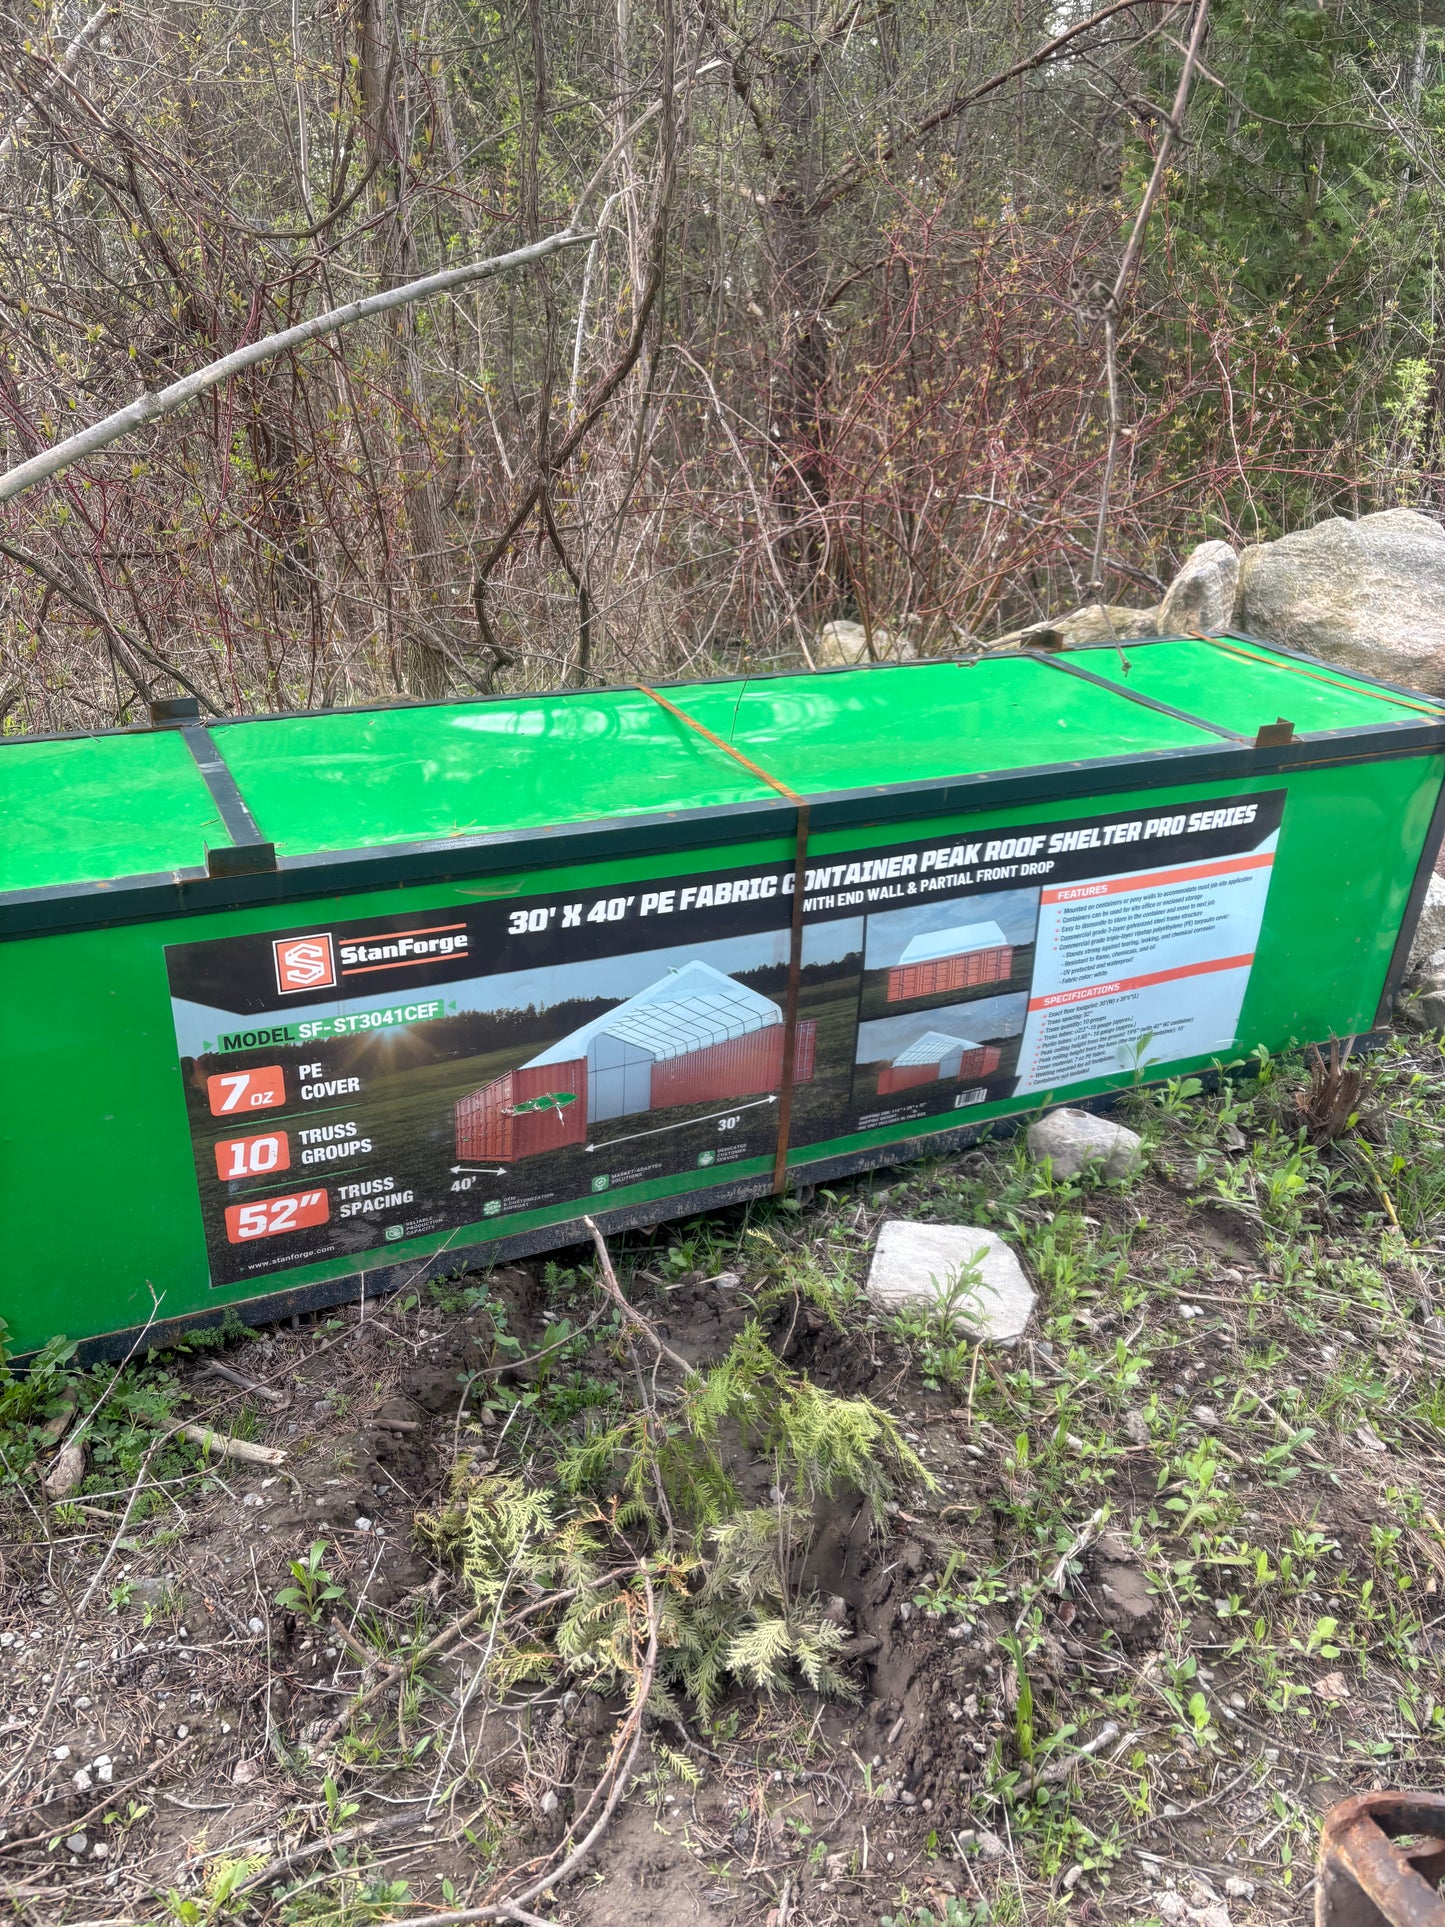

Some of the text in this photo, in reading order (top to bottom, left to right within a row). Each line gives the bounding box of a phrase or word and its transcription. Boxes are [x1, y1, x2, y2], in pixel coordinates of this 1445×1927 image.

[508, 907, 556, 934] 30'
[562, 904, 582, 928] X
[640, 890, 676, 916] PE
[680, 876, 777, 910] FABRIC
[782, 854, 918, 894] CONTAINER
[920, 843, 981, 872] PEAK
[984, 835, 1046, 862] ROOF
[1048, 822, 1142, 853] SHELTER
[1143, 815, 1186, 840] PRO
[1187, 804, 1258, 833] SERIES
[803, 860, 1055, 912] WITH END WALL & PARTIAL FRONT DROP
[1058, 884, 1108, 900] FEATURES
[1063, 904, 1087, 914] Mounted
[1095, 900, 1122, 908] containers
[1129, 896, 1142, 904] pony
[1163, 886, 1197, 896] accommodate
[1210, 881, 1218, 889] job
[1062, 914, 1090, 923] Containers
[1110, 907, 1122, 915] used
[1163, 896, 1184, 905] enclosed
[1081, 919, 1107, 929] dismantle
[1143, 910, 1166, 918] container
[1207, 899, 1215, 907] job
[1059, 939, 1090, 950] Commercial
[1091, 937, 1106, 946] grade
[1134, 929, 1152, 937] ripstop
[1152, 923, 1183, 934] polyethylene
[1194, 916, 1215, 925] tarpaulin
[1060, 930, 1091, 941] Commercial
[1092, 928, 1107, 937] grade
[1126, 919, 1152, 931] galvanized
[1181, 911, 1203, 919] structure
[340, 934, 468, 964] StanForge
[1066, 950, 1084, 958] Stands
[1102, 942, 1120, 952] against
[1171, 928, 1192, 938] chemical
[1193, 925, 1216, 933] corrosion
[1064, 957, 1088, 966] Resistant
[1071, 964, 1095, 975] protected
[1107, 956, 1134, 967] waterproof
[1062, 976, 1078, 984] Fabric
[1094, 970, 1108, 978] white
[1044, 984, 1120, 1006] SPECIFICATIONS
[1049, 1009, 1063, 1017] Exact
[1090, 1016, 1107, 1025] groups
[222, 1027, 295, 1050] MODEL
[299, 1062, 322, 1080] PE
[220, 1074, 250, 1110] 7
[301, 1077, 360, 1100] COVER
[298, 1122, 357, 1145] TRUSS
[228, 1136, 278, 1176] 10
[301, 1138, 372, 1164] GROUPS
[717, 1144, 747, 1153] DEDICATED
[717, 1148, 746, 1158] CUSTOMER
[338, 1177, 394, 1200] TRUSS
[612, 1172, 642, 1184] SOLUTIONS
[340, 1190, 414, 1218] SPACING
[406, 1216, 432, 1226] RELIABLE
[406, 1219, 443, 1230] PRODUCTION
[406, 1225, 435, 1236] CAPACITY
[248, 1245, 334, 1270] www.stanforge.com
